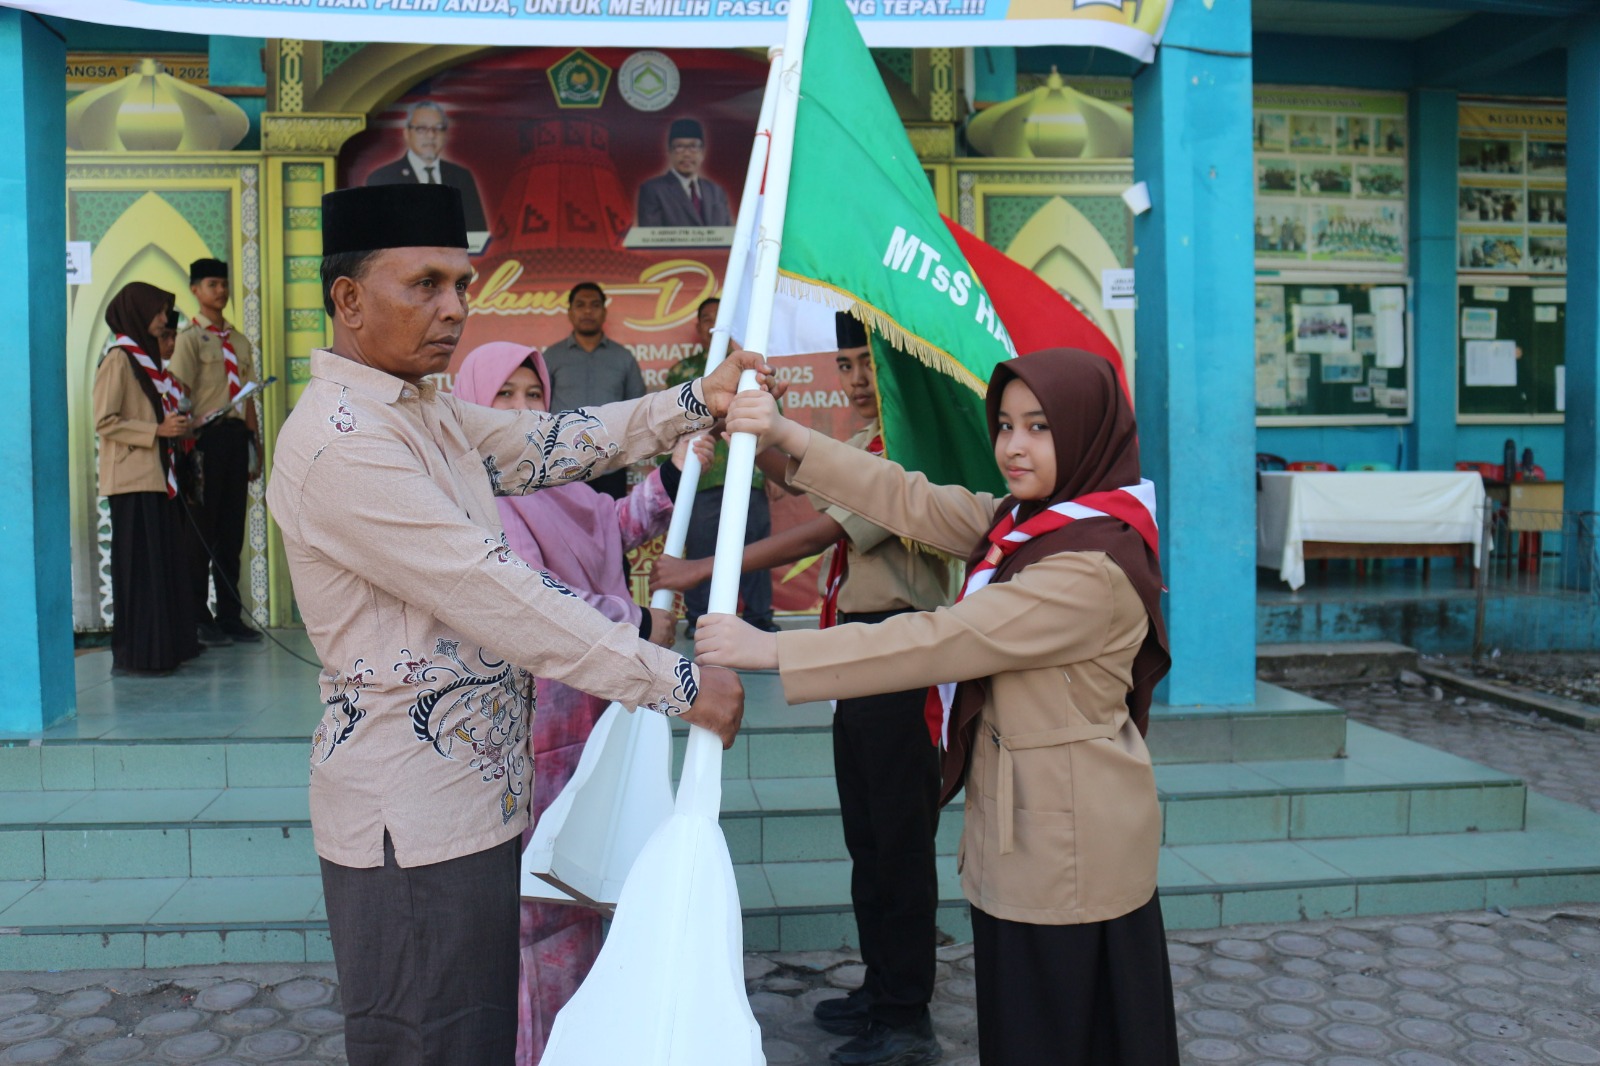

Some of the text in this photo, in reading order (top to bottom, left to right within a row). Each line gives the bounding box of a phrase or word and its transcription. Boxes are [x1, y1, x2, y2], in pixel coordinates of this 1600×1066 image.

[373, 0, 440, 11] PILIH
[443, 0, 518, 17] ANDA,
[524, 0, 602, 15] UNTUK
[607, 0, 710, 17] MEMILIH
[716, 0, 790, 16] PASLO
[882, 0, 987, 16] TEPAT..!!!
[66, 66, 118, 77] ANGSA
[1556, 116, 1566, 127] M
[882, 225, 972, 307] MTsS
